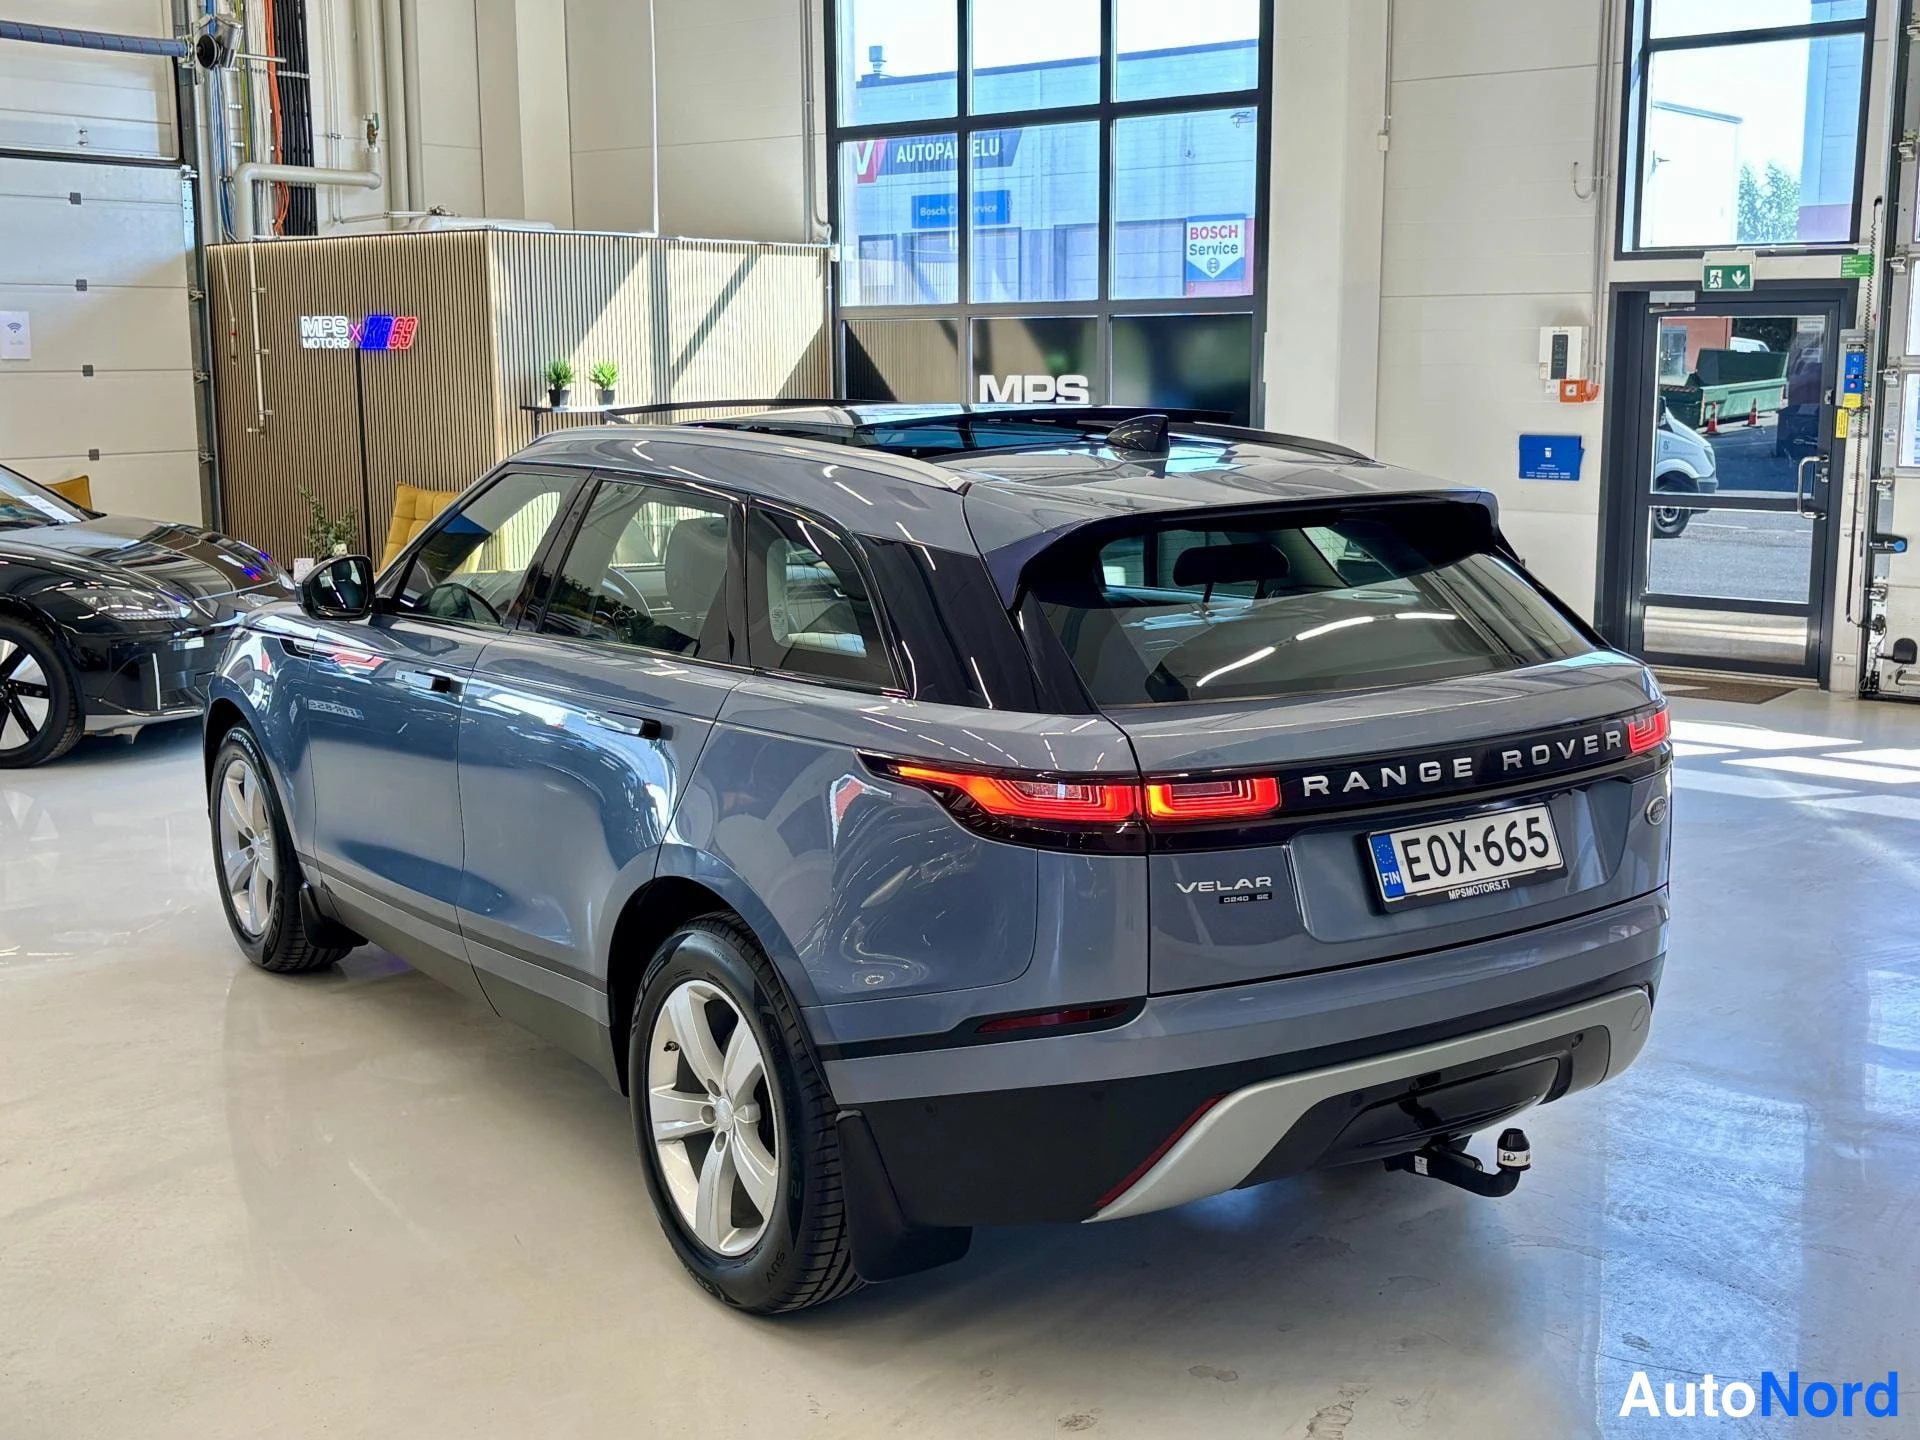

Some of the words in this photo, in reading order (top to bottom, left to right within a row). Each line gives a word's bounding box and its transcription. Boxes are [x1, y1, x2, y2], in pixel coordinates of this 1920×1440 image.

[896, 137, 1000, 164] AUTOPAELU
[1190, 225, 1239, 240] BOSCH
[1189, 241, 1239, 256] Service
[300, 315, 349, 338] MPS
[302, 337, 350, 349] MOTORS
[979, 374, 1090, 405] MPS
[1302, 757, 1473, 797] RANGE
[1502, 730, 1622, 771] ROVER
[1175, 876, 1272, 894] VELAR
[1381, 871, 1401, 887] FIN
[1448, 879, 1511, 900] MPSMOTORS.FI
